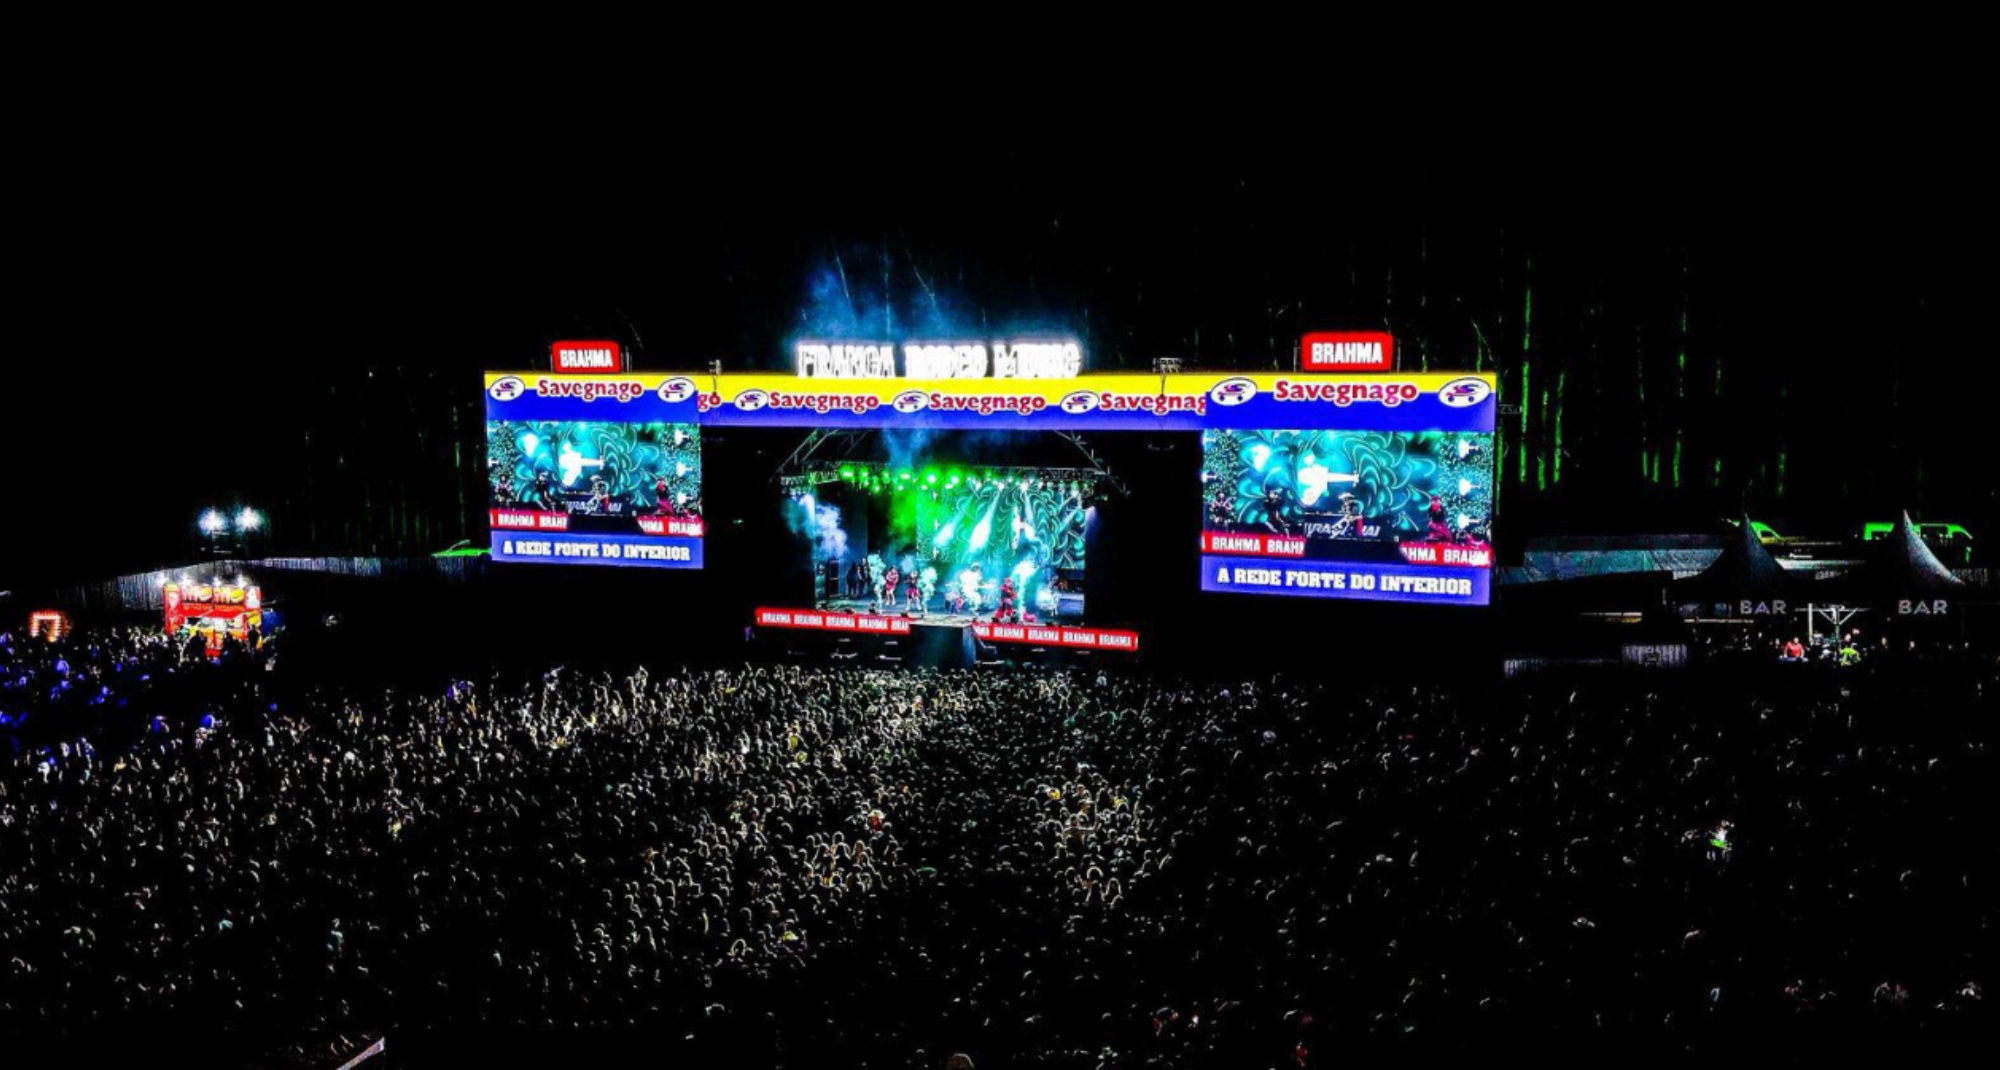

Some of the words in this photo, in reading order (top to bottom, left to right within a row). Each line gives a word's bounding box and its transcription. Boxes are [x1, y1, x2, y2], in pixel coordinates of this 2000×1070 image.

[559, 348, 613, 367] BRAHMA
[1312, 342, 1383, 364] BRAHMA
[538, 380, 642, 401] Savegnago
[1275, 381, 1418, 405] Savegnago
[769, 392, 879, 412] Savegnago
[930, 393, 1045, 414] Savegnago
[498, 514, 535, 526] BRAHMA
[503, 541, 514, 554] A
[516, 541, 551, 555] REDE
[554, 543, 599, 557] FORTE
[602, 545, 621, 558] DO
[624, 545, 690, 561] INTERIOR
[1212, 538, 1260, 553] BRAHMA
[1217, 568, 1230, 583] A
[1234, 569, 1281, 586] REDE
[1286, 571, 1345, 589] FORTE
[1350, 574, 1374, 591] DO
[1381, 576, 1472, 595] INTERIOR
[1740, 600, 1786, 615] BAR
[1898, 600, 1947, 615] BAR
